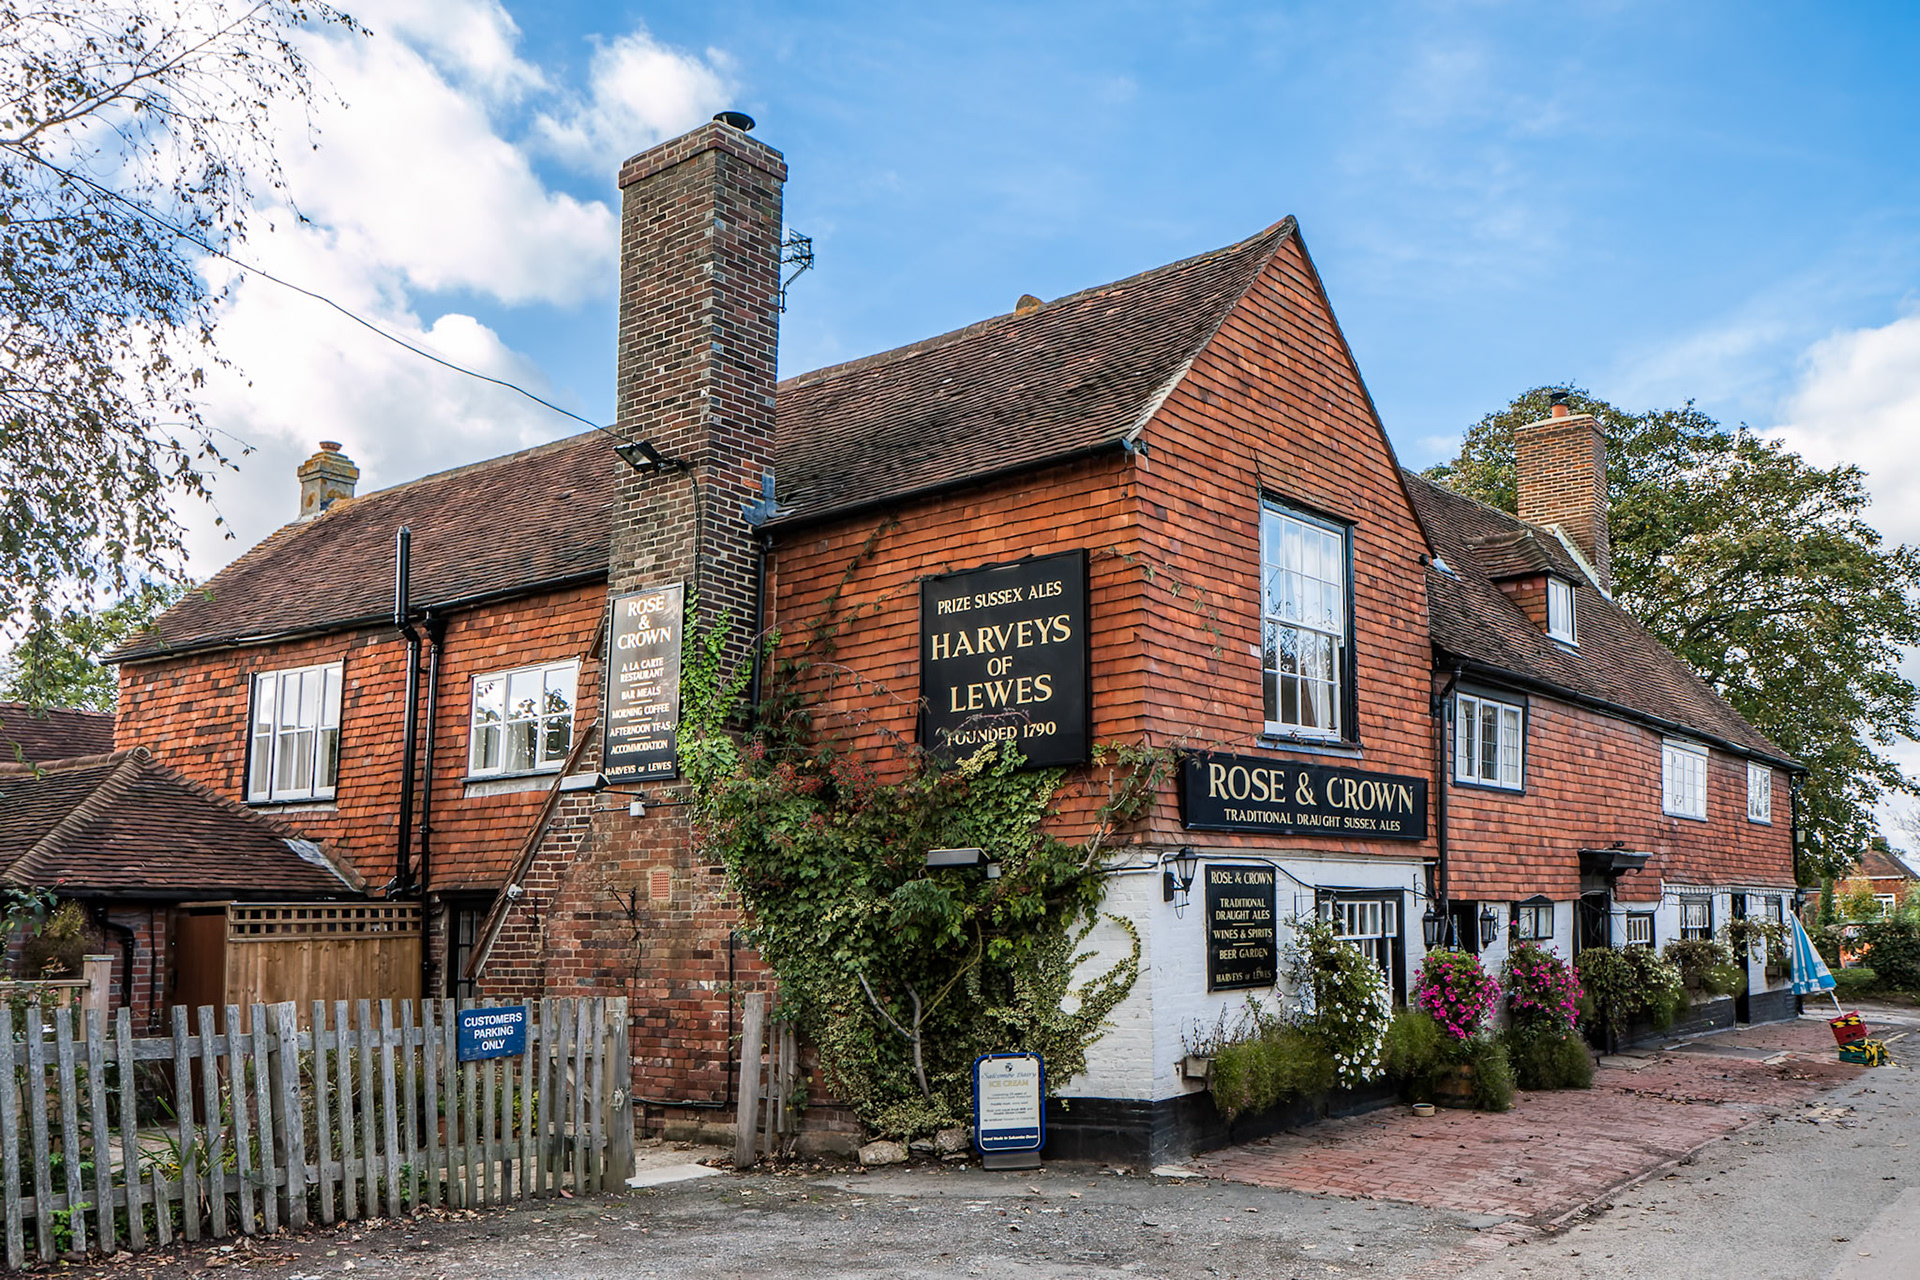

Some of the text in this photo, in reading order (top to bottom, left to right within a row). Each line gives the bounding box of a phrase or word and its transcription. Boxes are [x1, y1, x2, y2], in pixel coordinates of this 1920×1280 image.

[938, 580, 1062, 615] PRIZE SUSSEX ALES
[628, 596, 665, 616] ROSE
[638, 614, 650, 630] &
[618, 626, 672, 650] CROWN
[931, 614, 1072, 661] HARVEYS
[622, 657, 664, 672] A LA CARTE
[986, 656, 1014, 676] OF
[620, 668, 664, 683] RESTAURANT
[621, 686, 662, 700] BAR MEALS
[950, 674, 1052, 712] LEWES
[612, 703, 670, 719] MORNING COFFEE
[610, 721, 671, 737] AFTERNOON TEAS
[1023, 721, 1056, 738] 1790
[610, 740, 668, 755] ACCOMMODATION
[605, 764, 636, 776] HARVEYS
[648, 761, 672, 772] LEWES
[1208, 762, 1414, 814] ROSE & CROWN
[1224, 808, 1400, 831] TRADITIONAL DRAUGHT SUSSEX ALES
[1211, 871, 1272, 884] ROSE & CROWN
[1220, 898, 1266, 908] TRADITIONAL
[1216, 910, 1270, 920] DRAUGHT ALES
[1212, 928, 1272, 939] WINES & SPIRITS
[1219, 948, 1268, 960] BEER GARDEN
[1216, 972, 1243, 982] HARVEYS
[1253, 970, 1272, 979] LEWES
[464, 1012, 522, 1027] CUSTOMERS
[474, 1026, 514, 1039] PARKING
[482, 1040, 505, 1050] ONLY
